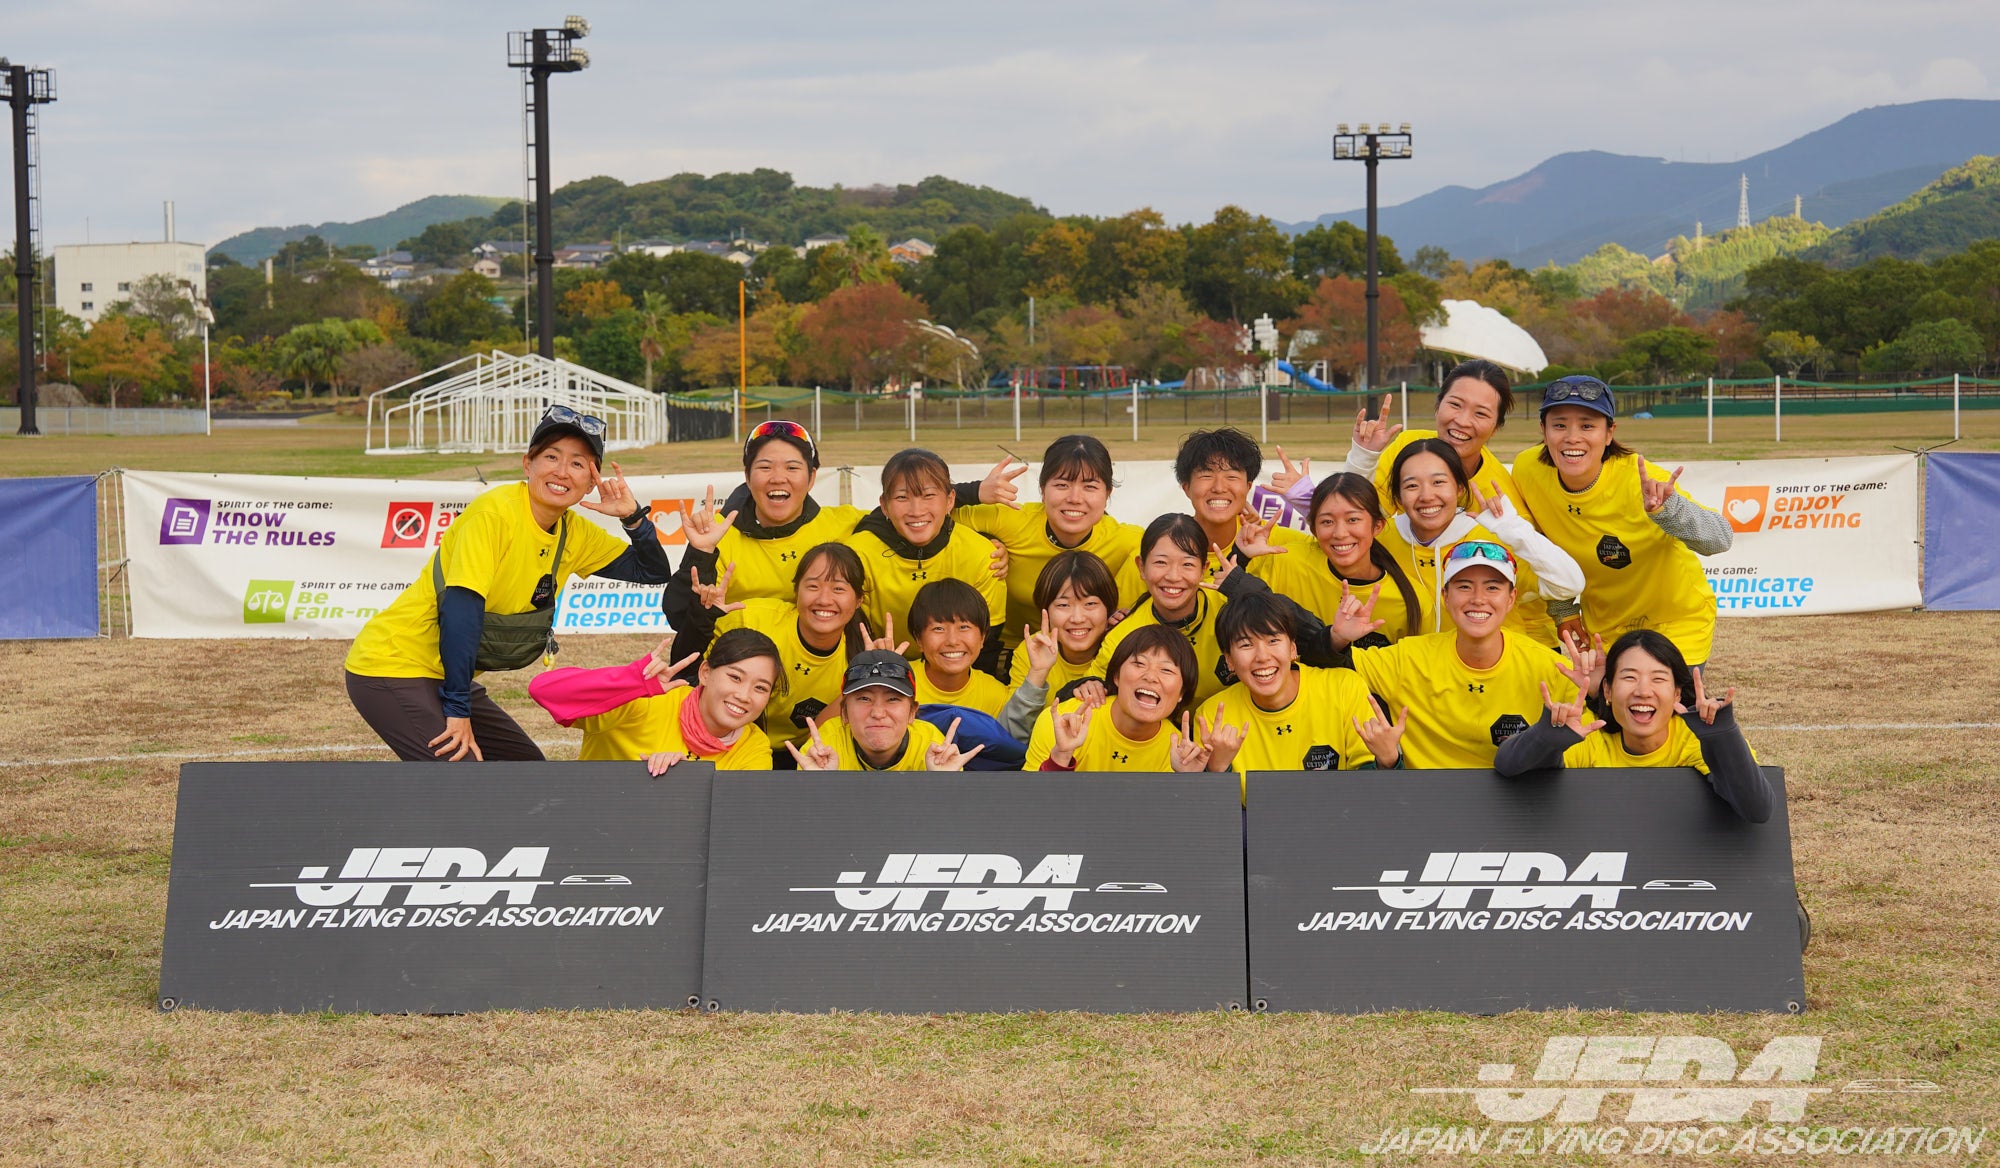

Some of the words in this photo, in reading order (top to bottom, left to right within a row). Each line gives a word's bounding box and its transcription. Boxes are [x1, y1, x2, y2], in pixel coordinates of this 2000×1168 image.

[1776, 485, 1810, 494] SPIRIT
[1813, 485, 1827, 493] OF
[217, 501, 252, 509] SPIRIT
[300, 581, 336, 590] SPIRIT
[339, 582, 353, 590] OF
[571, 582, 606, 590] SPIRIT
[295, 847, 550, 906] JFDA
[834, 853, 1084, 911] JFDA
[1377, 852, 1629, 909] JFDA
[209, 907, 307, 929] JAPAN
[307, 907, 407, 929] FLYING
[407, 907, 476, 929] DISC
[476, 907, 664, 929] ASSOCIATION
[752, 913, 844, 933] JAPAN
[848, 913, 945, 933] FLYING
[946, 913, 1015, 933] DISC
[1015, 913, 1201, 933] ASSOCIATION
[1298, 911, 1393, 931] JAPAN
[1394, 911, 1491, 931] FLYING
[1493, 911, 1563, 931] DISC
[1563, 911, 1753, 931] ASSOCIATION
